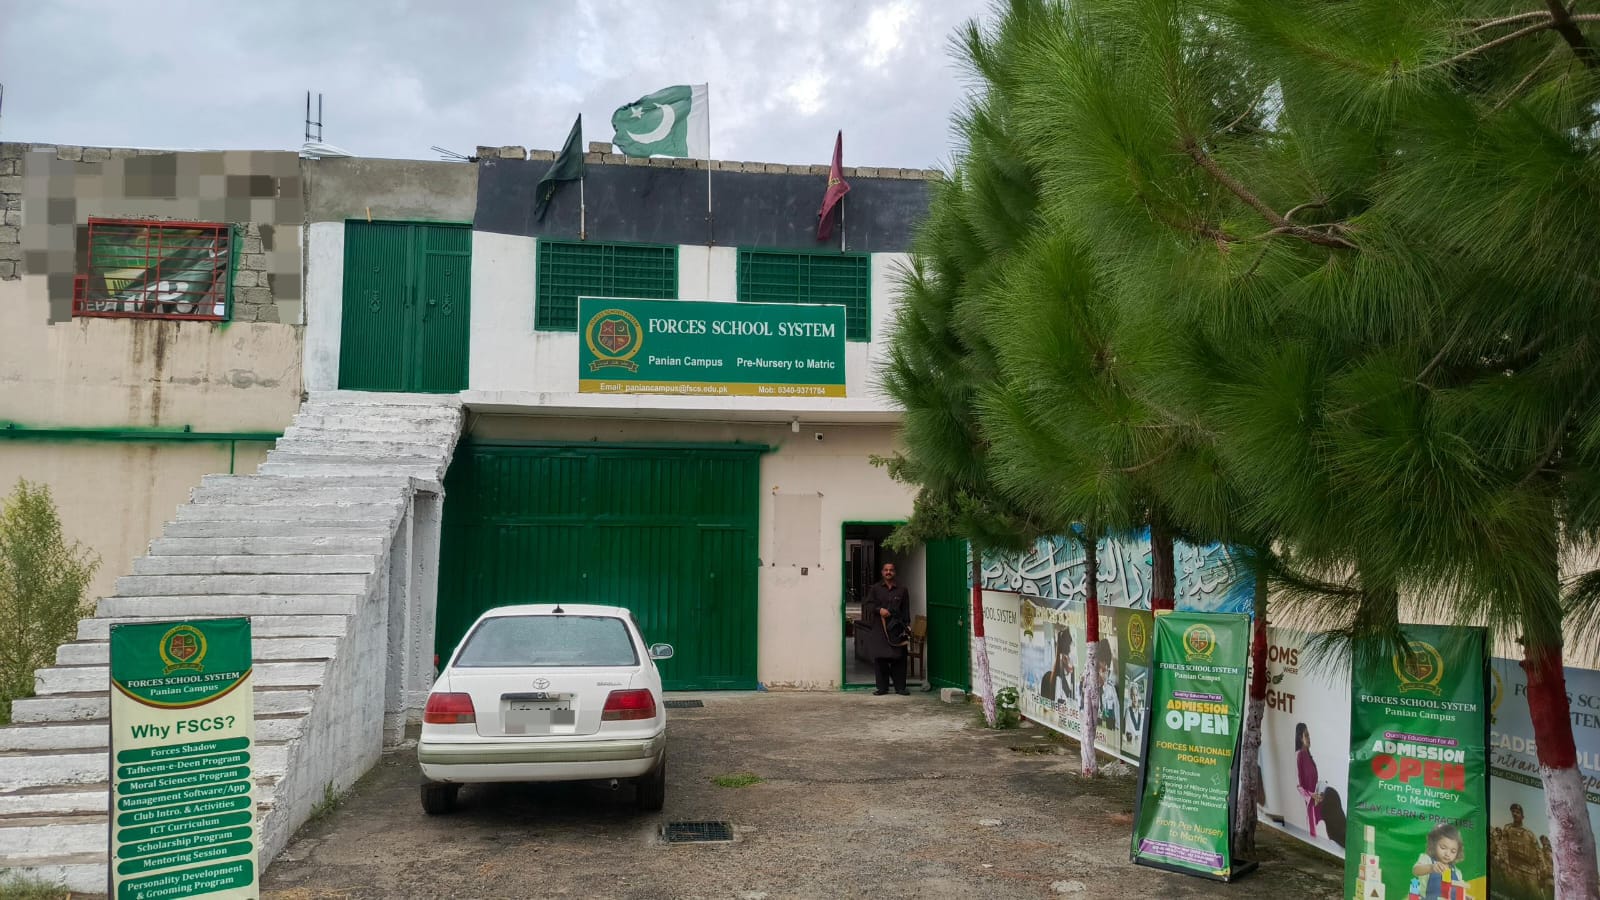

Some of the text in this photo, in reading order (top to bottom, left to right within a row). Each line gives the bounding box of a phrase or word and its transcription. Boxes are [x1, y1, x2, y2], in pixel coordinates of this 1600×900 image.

[648, 318, 836, 338] FORCES SCHOOL SYSTEM
[648, 355, 682, 367] Panian
[684, 356, 723, 369] Campus
[736, 357, 835, 370] Pre-Nursery to Matric
[600, 382, 625, 392] Email:
[1185, 664, 1212, 673] SCHOOL
[1212, 666, 1238, 675] SYSTEM
[128, 672, 240, 688] FORCES SCHOOL SYSTEM
[150, 684, 219, 696] Panian Campus
[1167, 699, 1229, 715] ADMISSION
[1361, 694, 1477, 712] FORCES SCHOOL SYSTEM
[1165, 710, 1230, 735] OPEN
[1385, 707, 1456, 722] Panian Campus
[131, 715, 236, 740] Why FSCS?
[1156, 740, 1187, 752] FORCES
[1386, 732, 1407, 741] Quality
[1408, 734, 1437, 744] Education
[151, 743, 217, 757] Forces Shadow
[1372, 740, 1465, 763] ADMISSION
[126, 754, 241, 775] Tafheem-e-Deen Program
[1177, 753, 1217, 765] PROGRAM
[130, 771, 238, 790] Moral Sciences Program
[1371, 755, 1465, 791] OPEN
[123, 784, 246, 807] Management Software/App
[1378, 780, 1460, 802] From Pre Nursery
[1397, 794, 1441, 809] to Matric
[133, 800, 235, 821] Club Intro. & Activities
[1386, 806, 1416, 820] LEARN
[1418, 811, 1427, 821] &
[150, 818, 220, 835] ICT Curriculum
[1156, 818, 1176, 828] From
[1193, 824, 1224, 838] Nursery
[137, 832, 233, 853] Scholarship Program
[1169, 829, 1208, 844] to Matric
[143, 847, 228, 868] Mentoring Session
[127, 864, 243, 891] Personality Development
[146, 883, 193, 899] Grooming
[194, 876, 234, 889] Program
